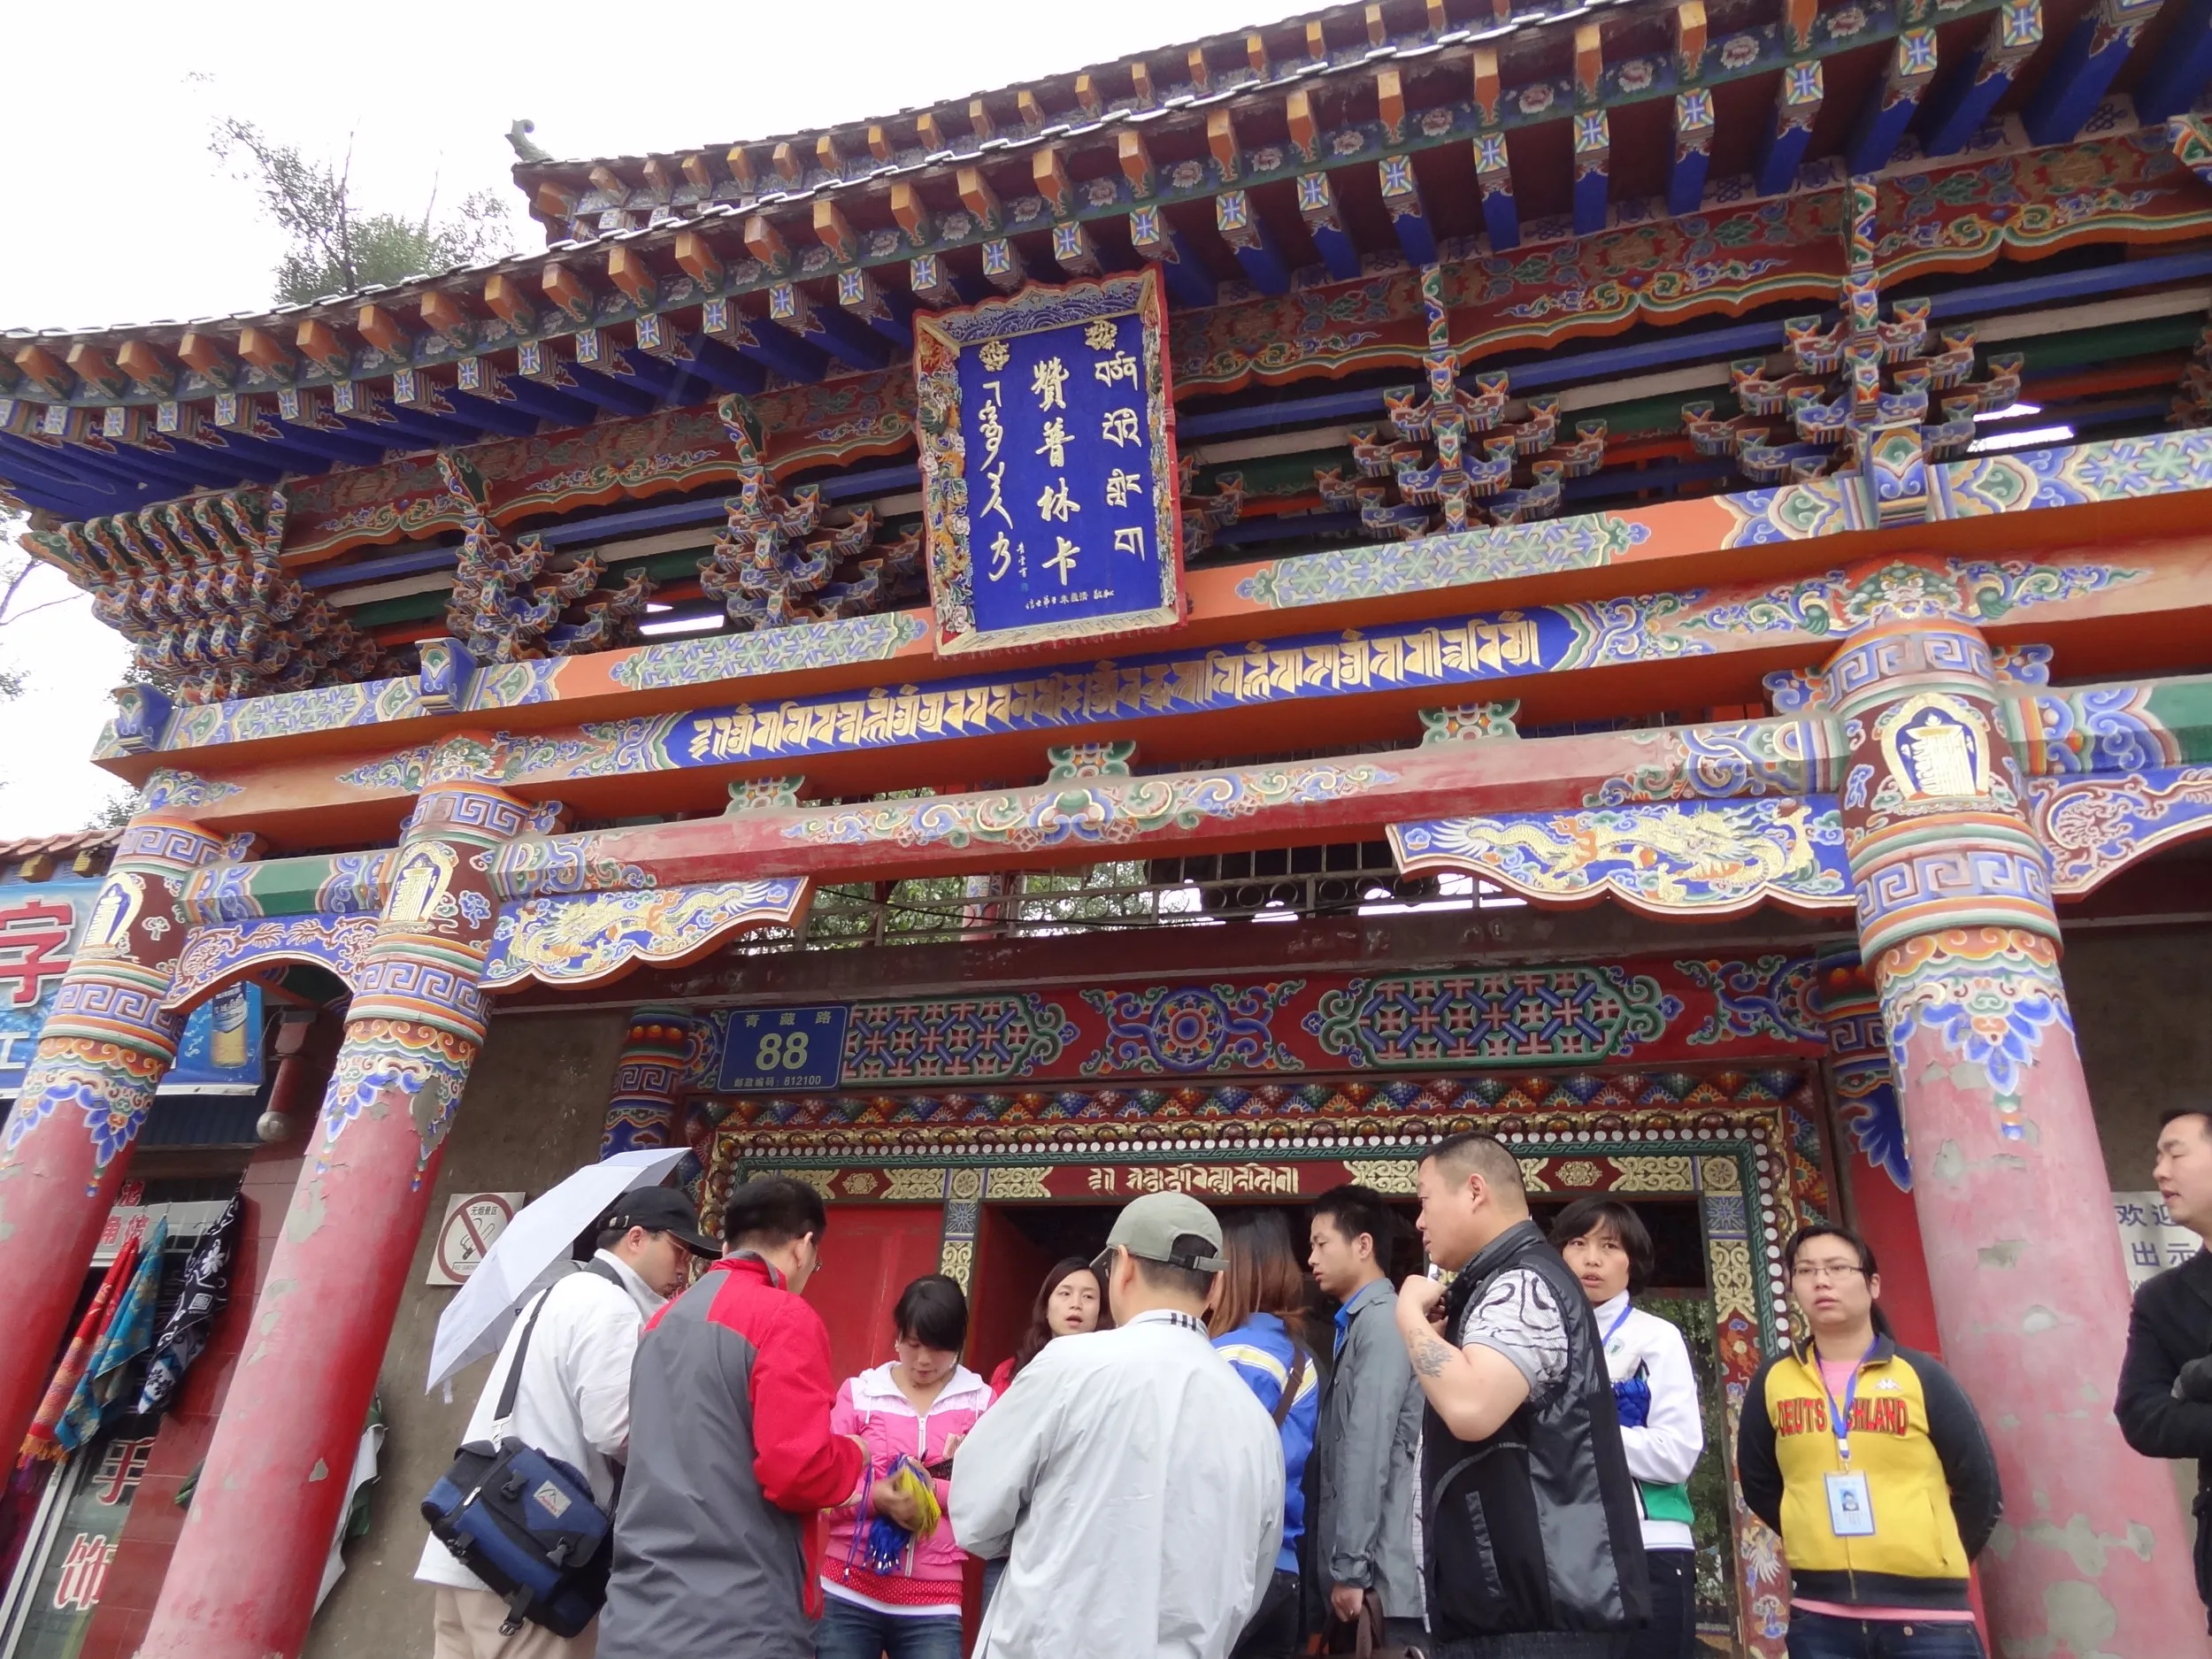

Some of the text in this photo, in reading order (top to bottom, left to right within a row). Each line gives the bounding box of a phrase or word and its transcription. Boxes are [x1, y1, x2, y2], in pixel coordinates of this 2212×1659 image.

[745, 1010, 832, 1028] 青藏路
[756, 1032, 809, 1071] 88
[784, 1075, 821, 1087] 812100
